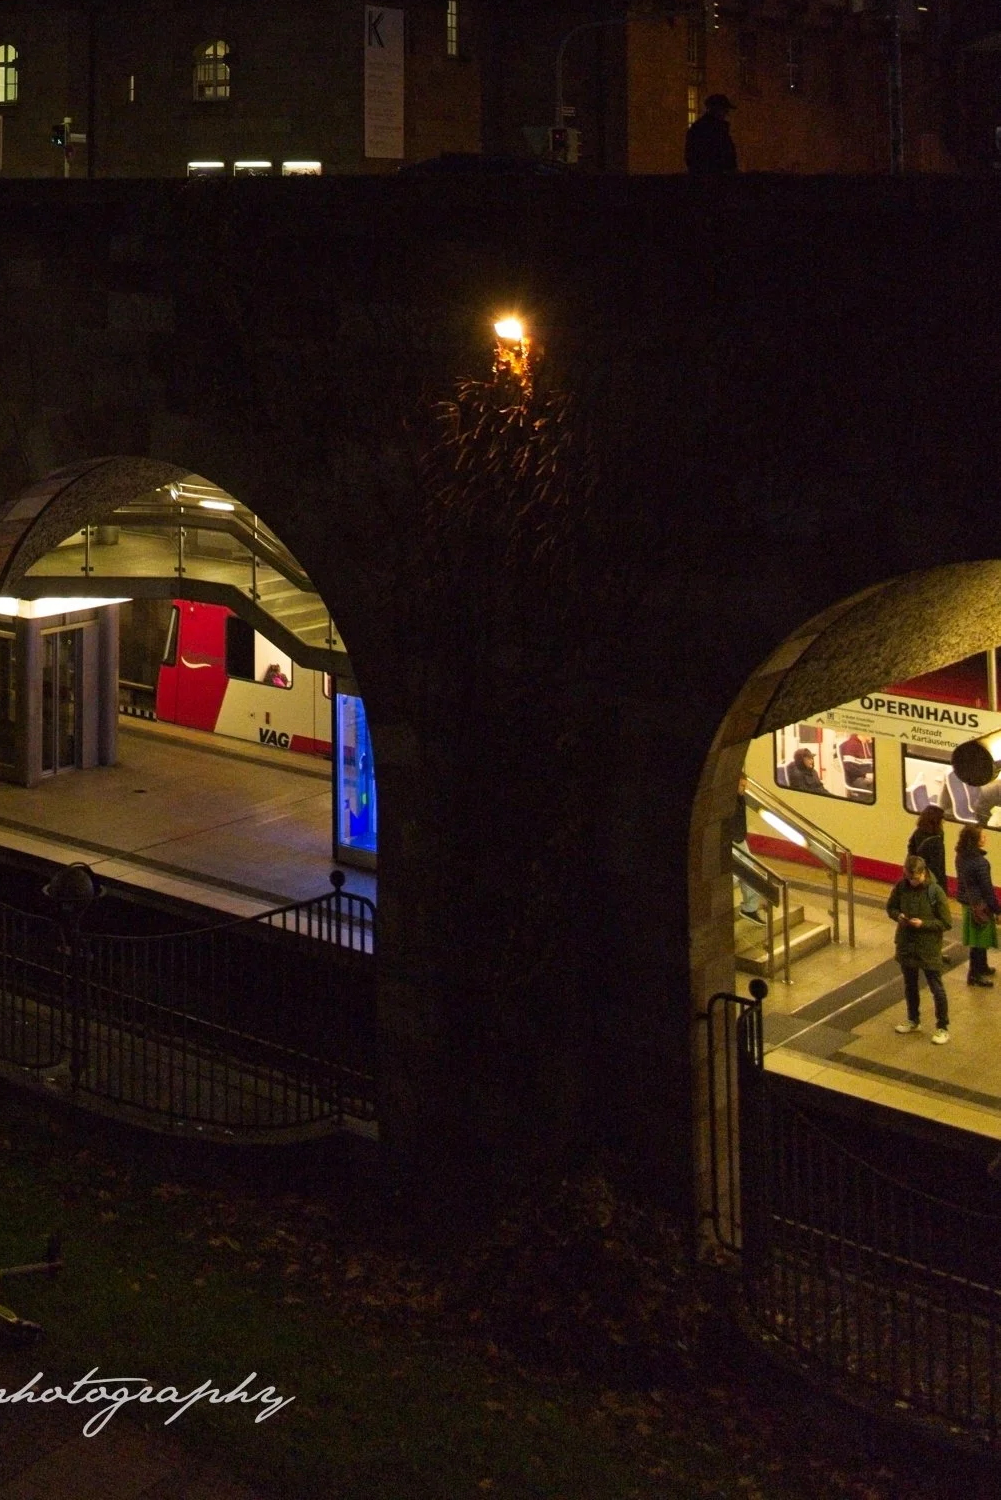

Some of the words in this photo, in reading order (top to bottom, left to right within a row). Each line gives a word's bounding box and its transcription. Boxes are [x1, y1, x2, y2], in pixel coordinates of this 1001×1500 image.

[367, 10, 385, 48] K
[860, 697, 979, 728] OPERNHAUS
[259, 727, 290, 748] VAG
[910, 726, 942, 737] Altstadt
